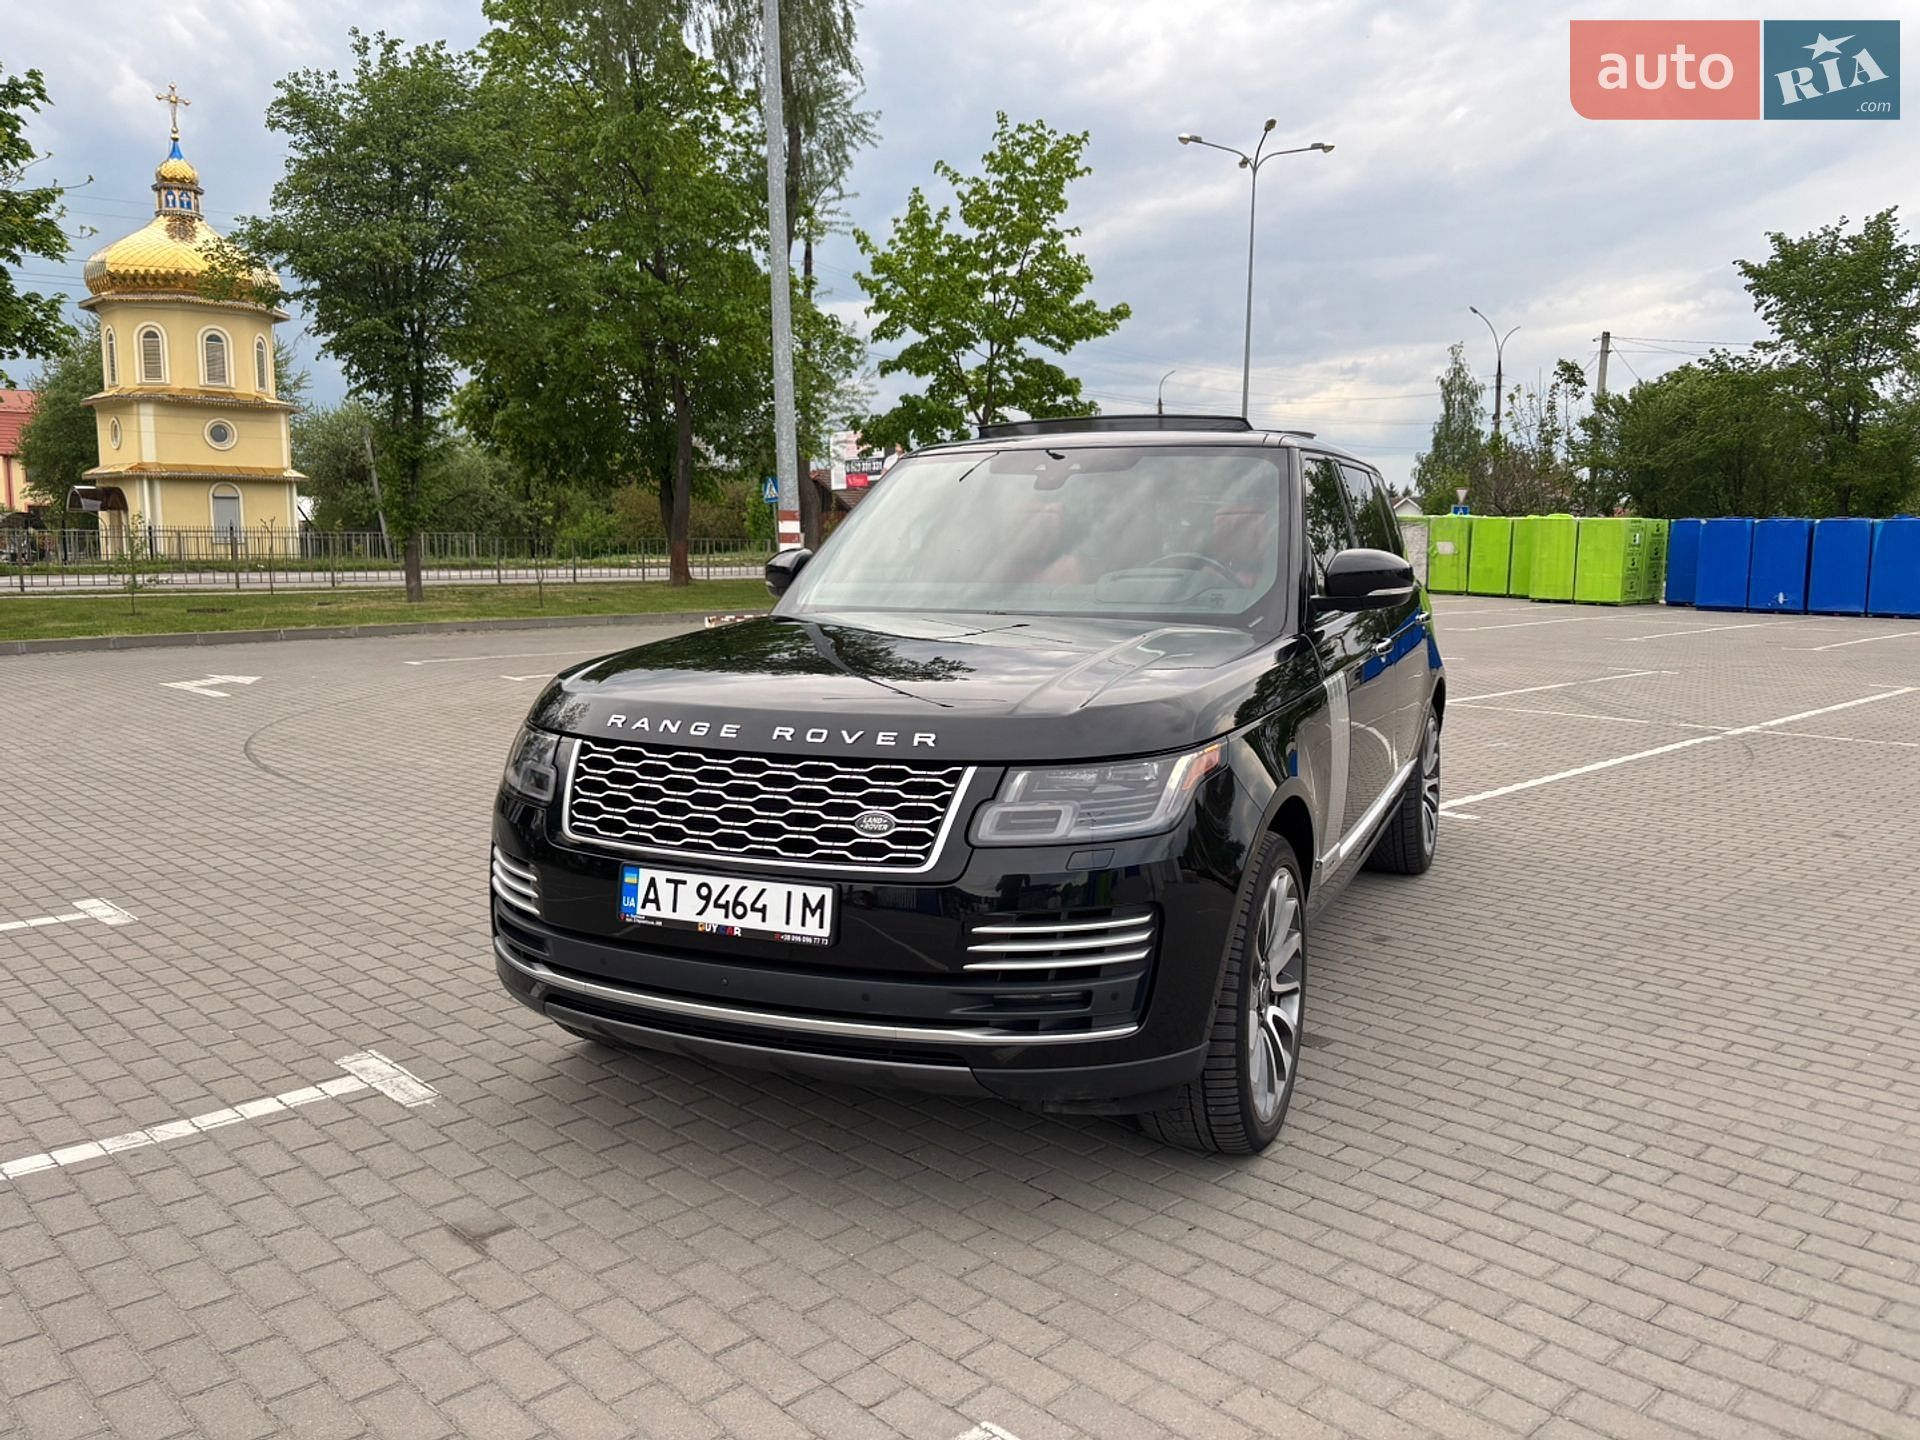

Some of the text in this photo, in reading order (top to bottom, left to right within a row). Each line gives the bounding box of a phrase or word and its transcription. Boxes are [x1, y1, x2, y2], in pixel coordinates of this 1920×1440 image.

[607, 714, 937, 747] RANGE ROVER
[622, 896, 636, 908] UA
[640, 876, 826, 929] AT 9464 IM
